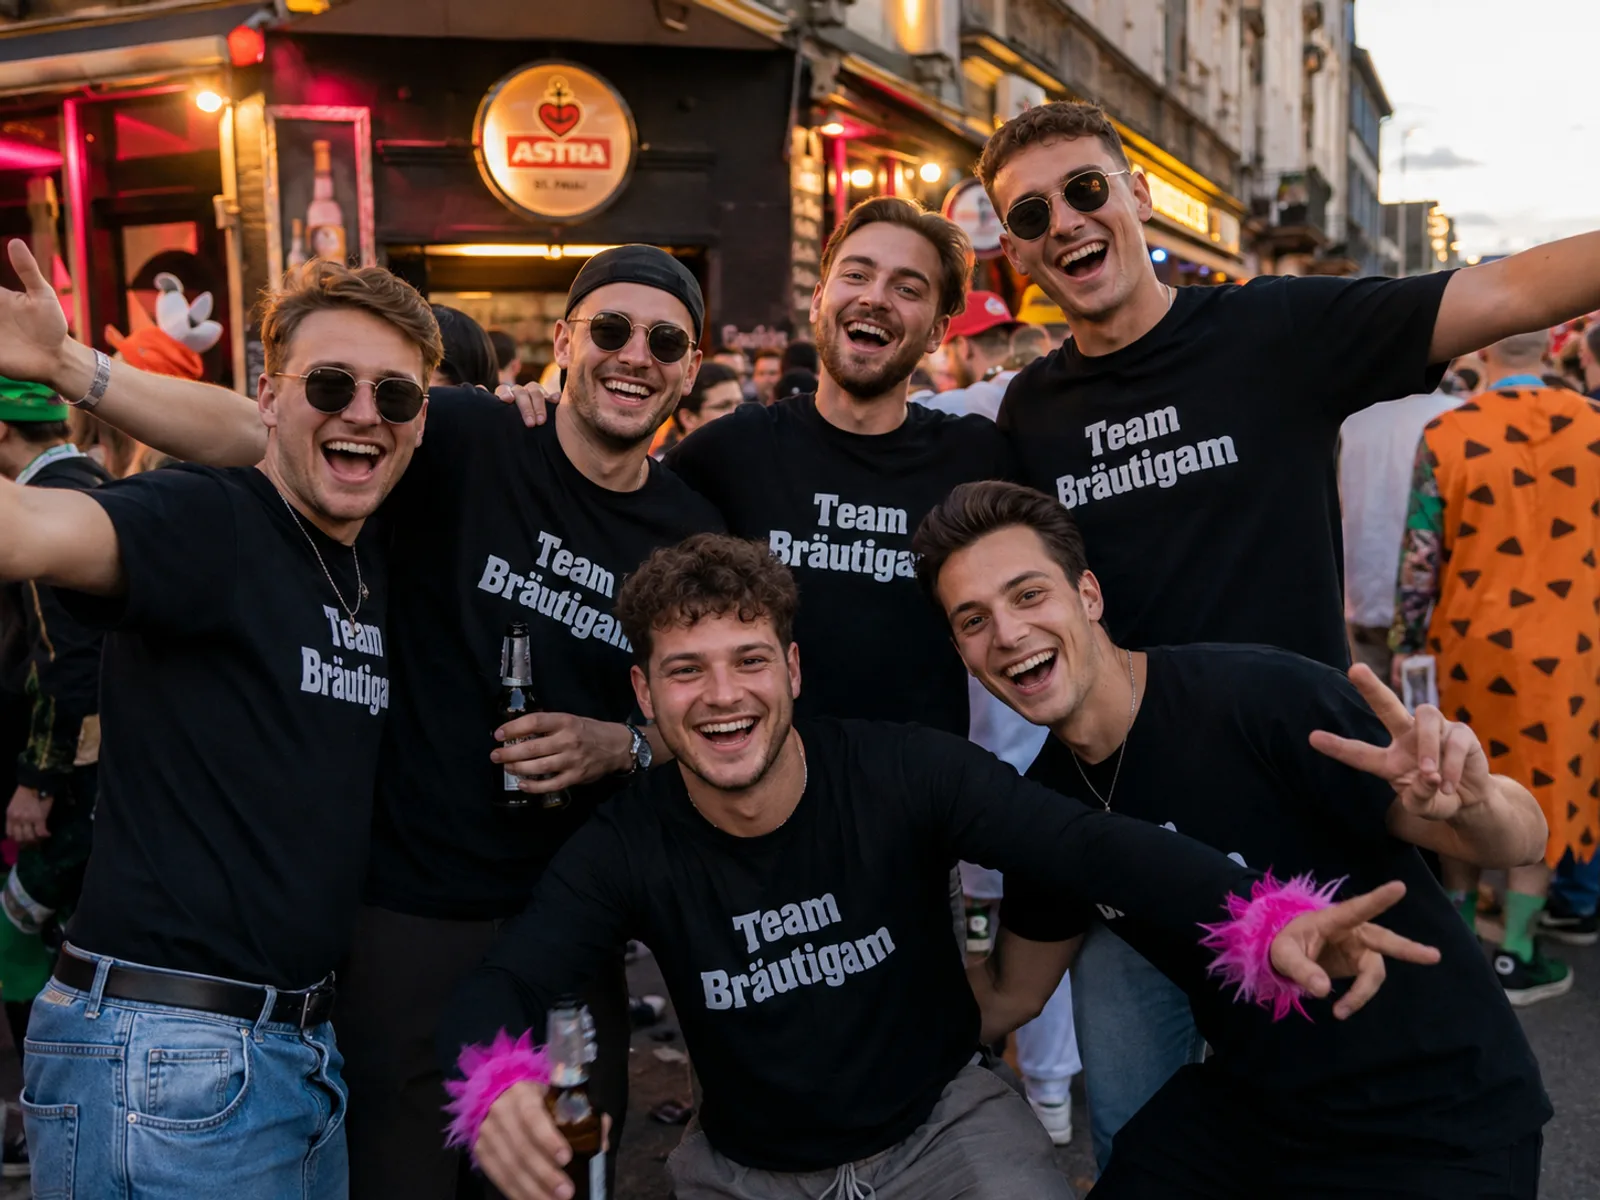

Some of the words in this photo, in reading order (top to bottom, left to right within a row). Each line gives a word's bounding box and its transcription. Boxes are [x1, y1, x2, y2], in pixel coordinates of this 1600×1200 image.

[510, 140, 608, 165] ASTRA
[1085, 405, 1181, 457] Team
[1056, 435, 1239, 510] Bräutigam
[813, 493, 908, 535] Team
[535, 530, 615, 599] Team
[769, 530, 918, 583] Bräutiga
[322, 604, 384, 657] Team
[300, 646, 390, 716] Bräutiga
[732, 892, 842, 954] Team
[700, 926, 896, 1010] Bräutigam
